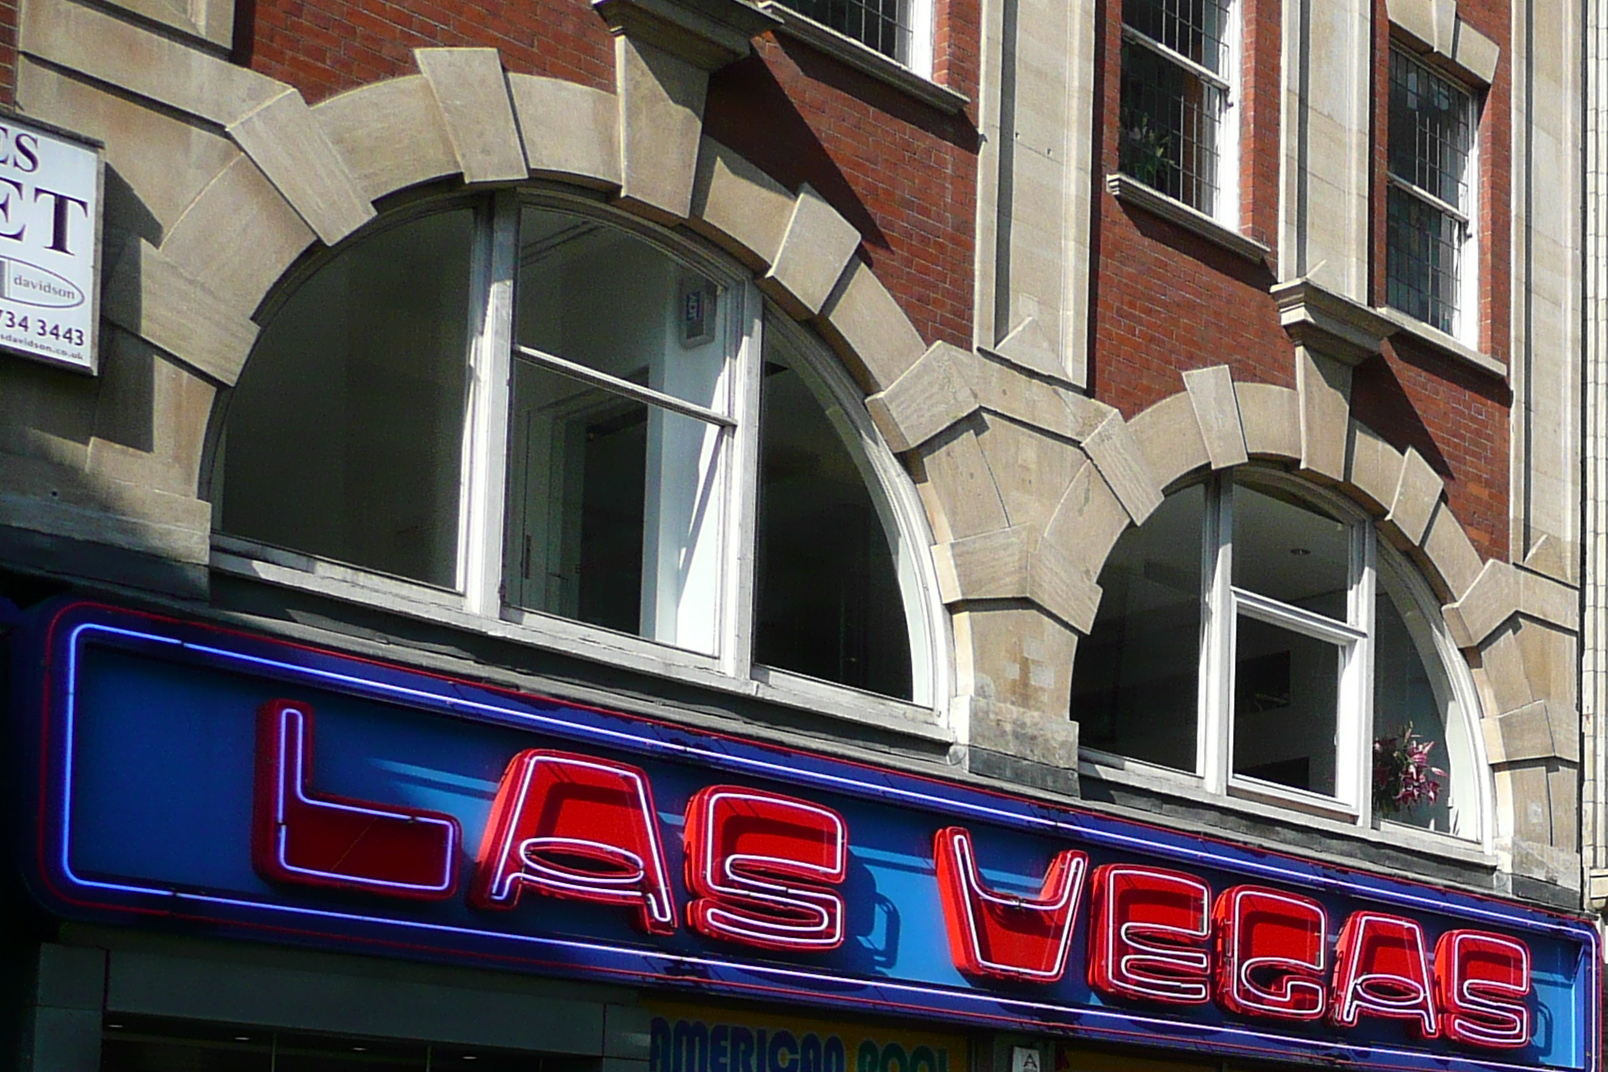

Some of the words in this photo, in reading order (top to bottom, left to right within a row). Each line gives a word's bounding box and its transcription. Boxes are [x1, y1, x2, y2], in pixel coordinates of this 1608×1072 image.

[13, 275, 76, 301] davidson
[37, 318, 85, 347] 3443
[252, 699, 848, 951] LAS
[933, 825, 1531, 1049] VEGAS
